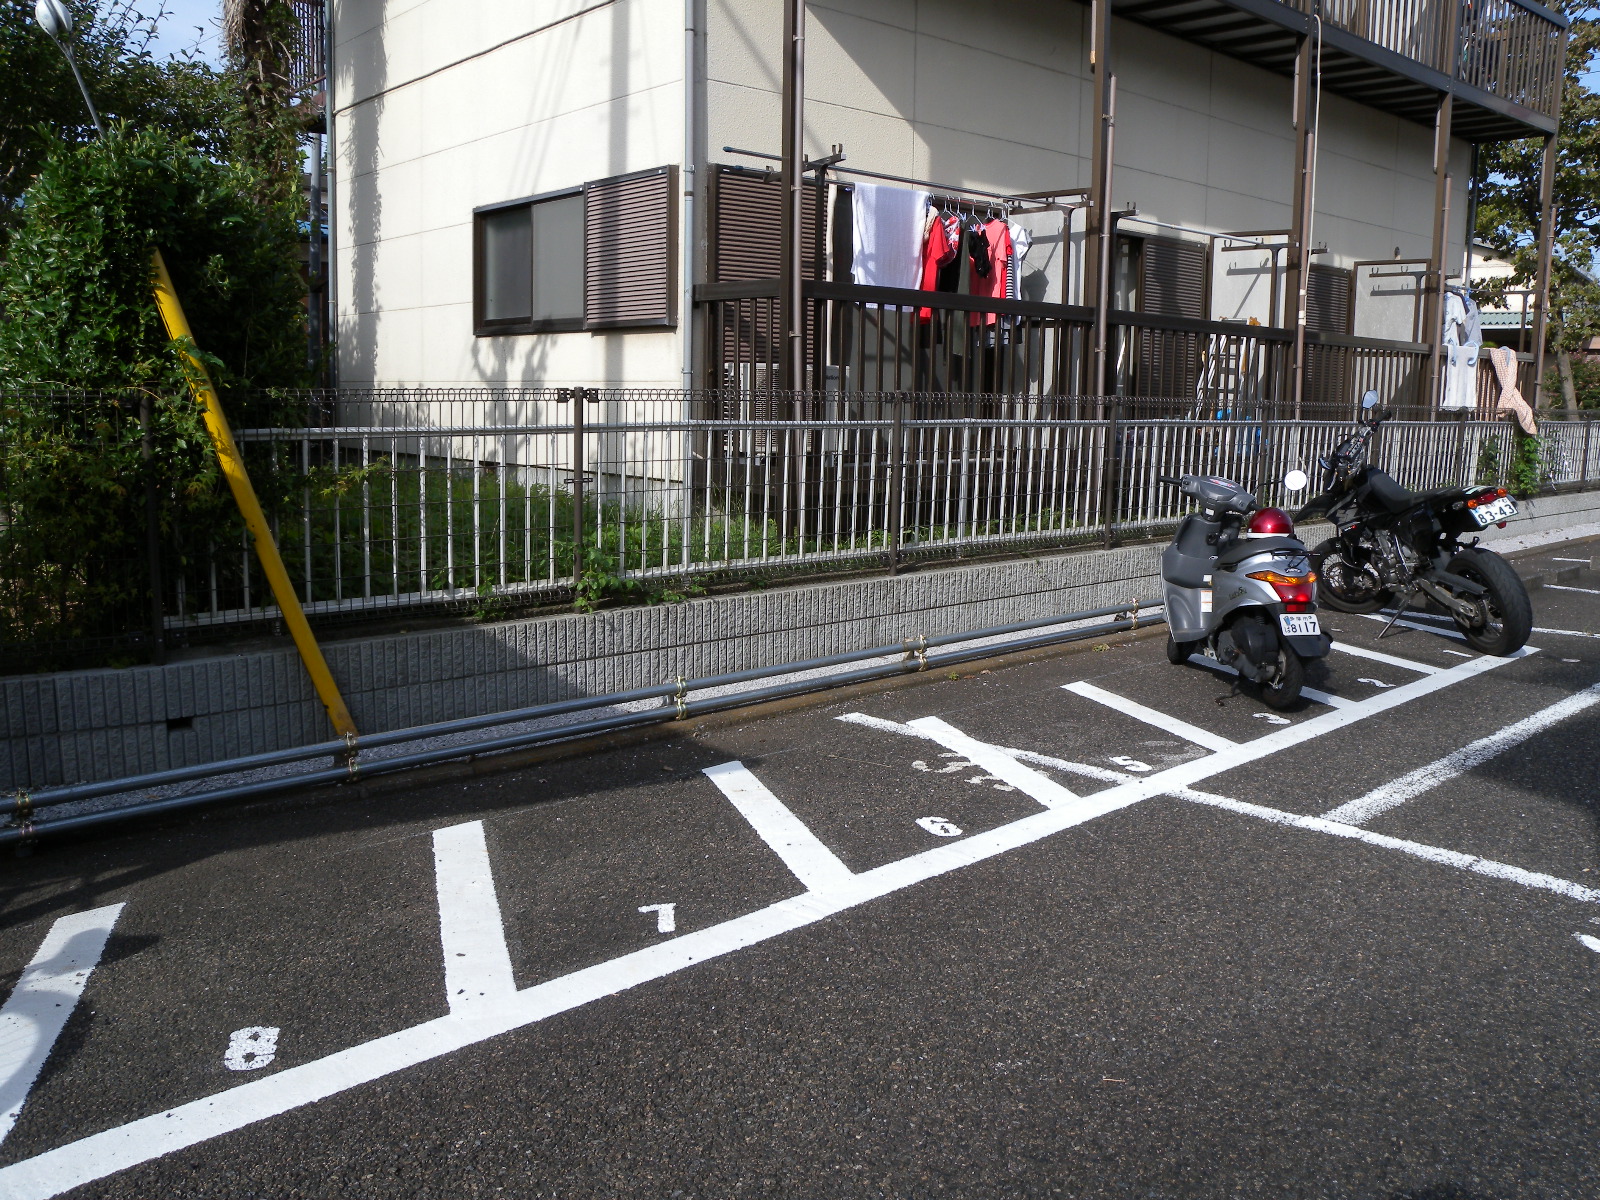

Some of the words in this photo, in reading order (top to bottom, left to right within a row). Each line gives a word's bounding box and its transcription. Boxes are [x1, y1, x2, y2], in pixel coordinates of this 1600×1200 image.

[1478, 504, 1515, 524] 83-43
[1290, 622, 1317, 633] 8117
[1109, 755, 1152, 772] 5
[915, 816, 963, 837] 6
[224, 1026, 280, 1071] 8
